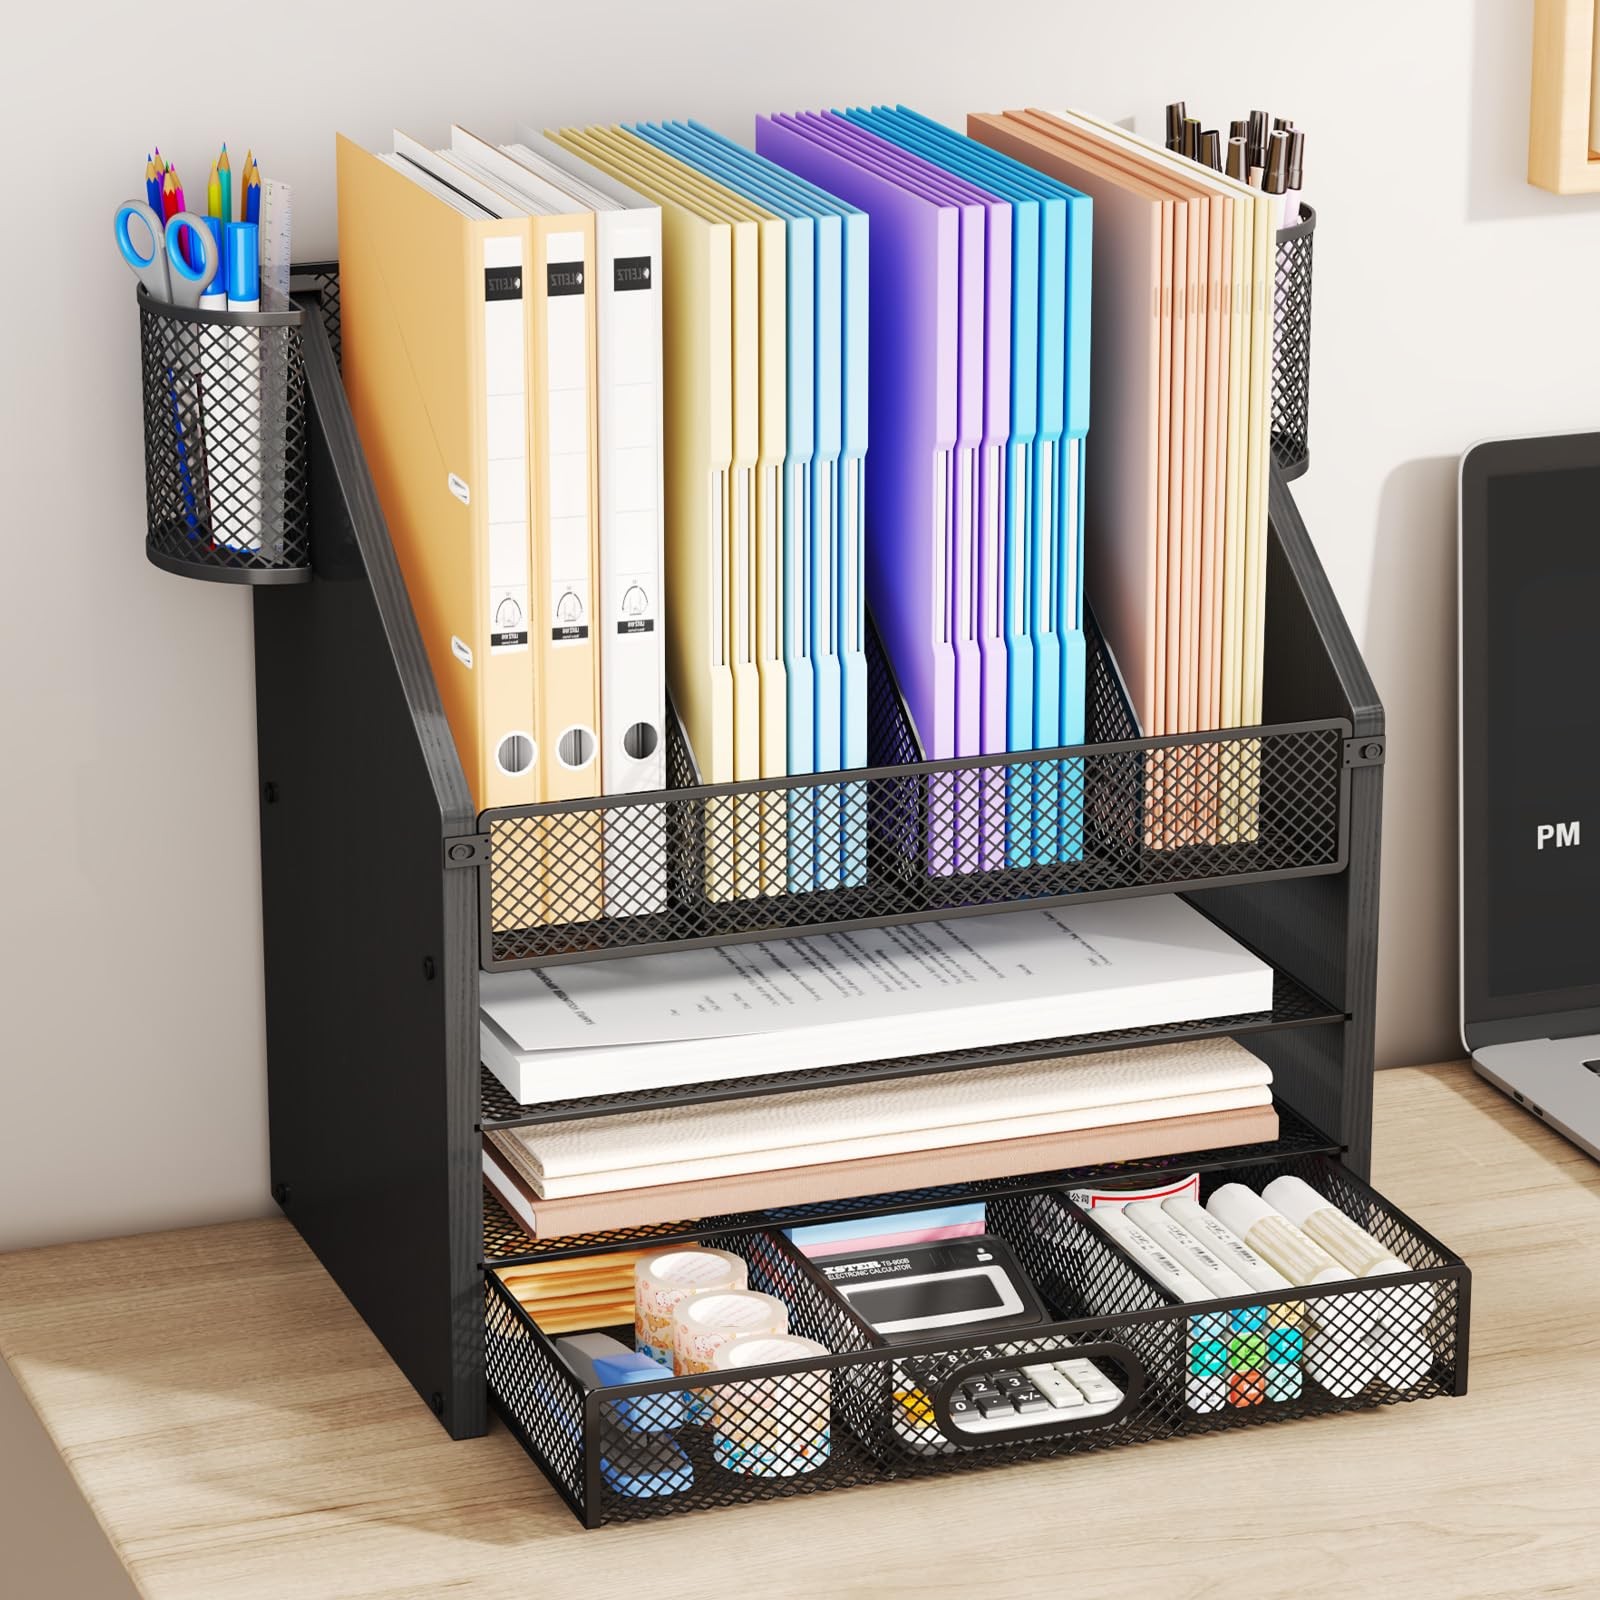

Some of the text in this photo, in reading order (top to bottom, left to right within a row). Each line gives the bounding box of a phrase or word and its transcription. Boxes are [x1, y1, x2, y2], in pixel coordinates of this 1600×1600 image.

[1537, 821, 1580, 850] PM
[1067, 1192, 1089, 1205] 公司
[827, 1263, 912, 1281] ELECTRONIC CALCULATOR
[976, 1383, 988, 1392] 2
[1008, 1378, 1021, 1387] 3
[1018, 1391, 1041, 1402] +/-
[955, 1401, 967, 1411] 0
